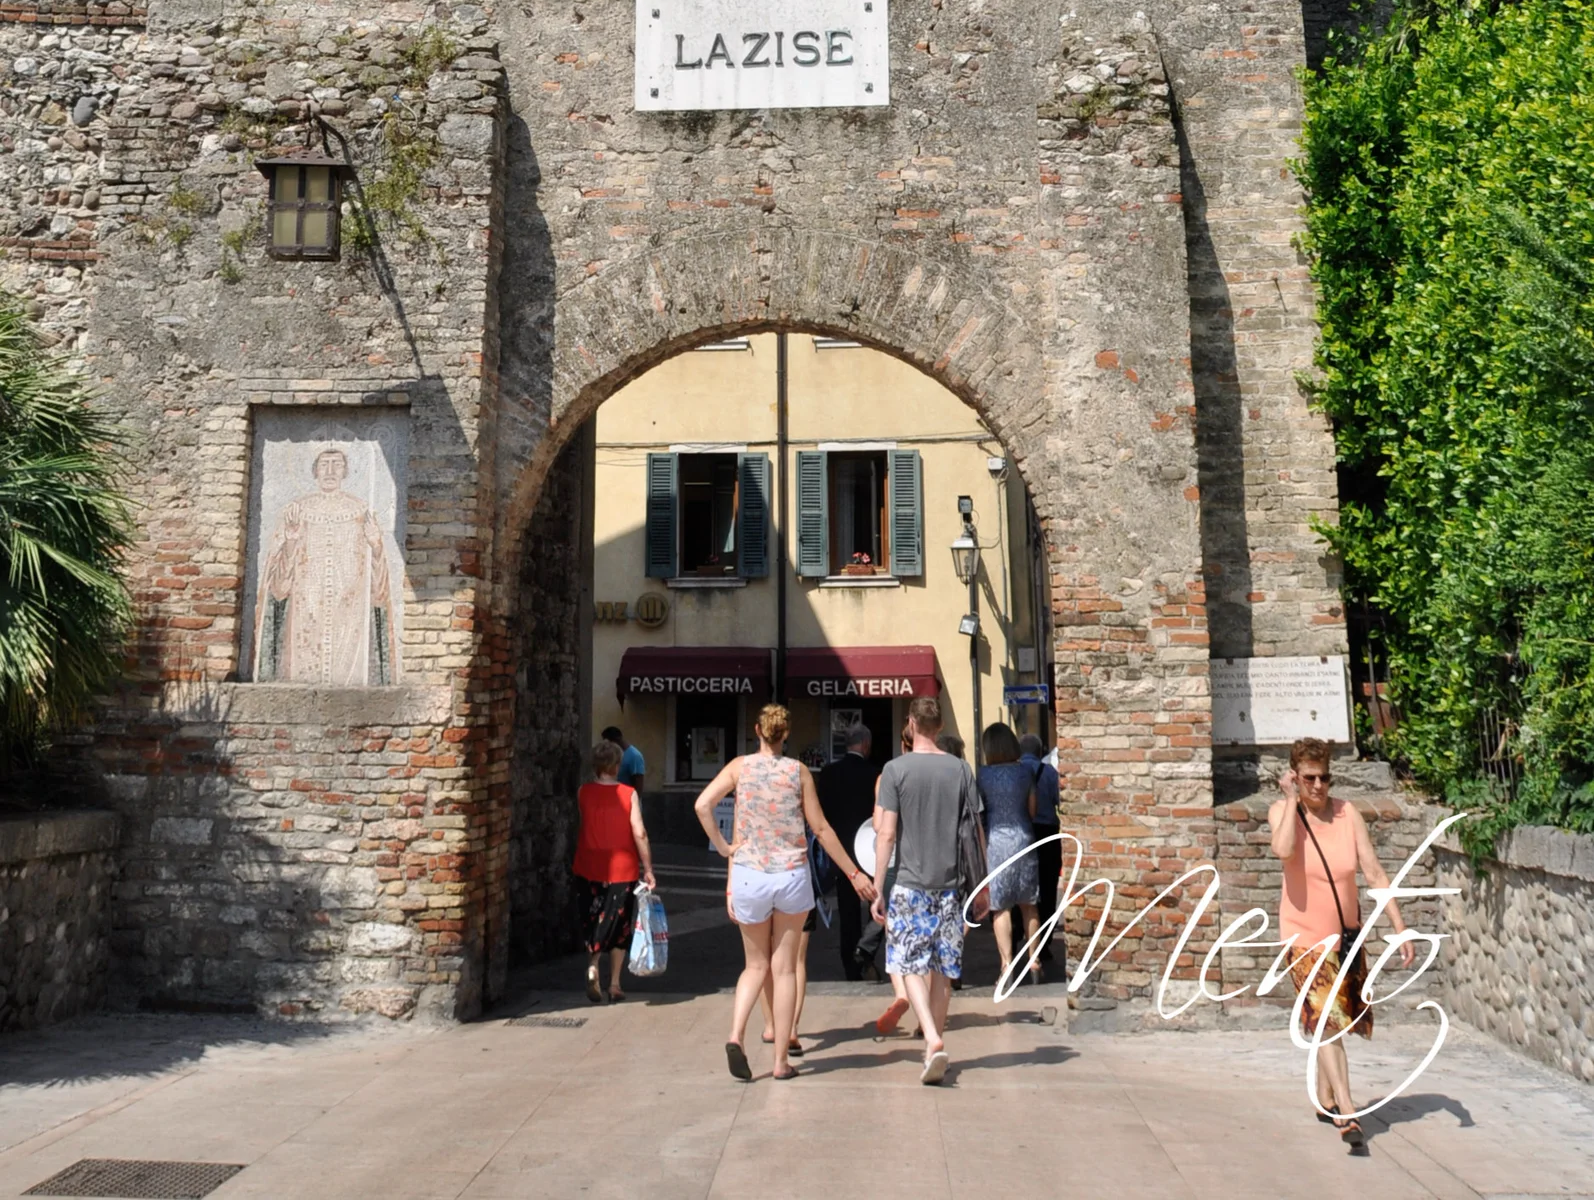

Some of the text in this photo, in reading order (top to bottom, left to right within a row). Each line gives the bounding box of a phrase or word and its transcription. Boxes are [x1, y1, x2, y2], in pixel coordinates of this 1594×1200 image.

[675, 30, 854, 70] LAZISE
[629, 676, 753, 693] PASTICCERIA
[807, 678, 914, 696] GELATERIA
